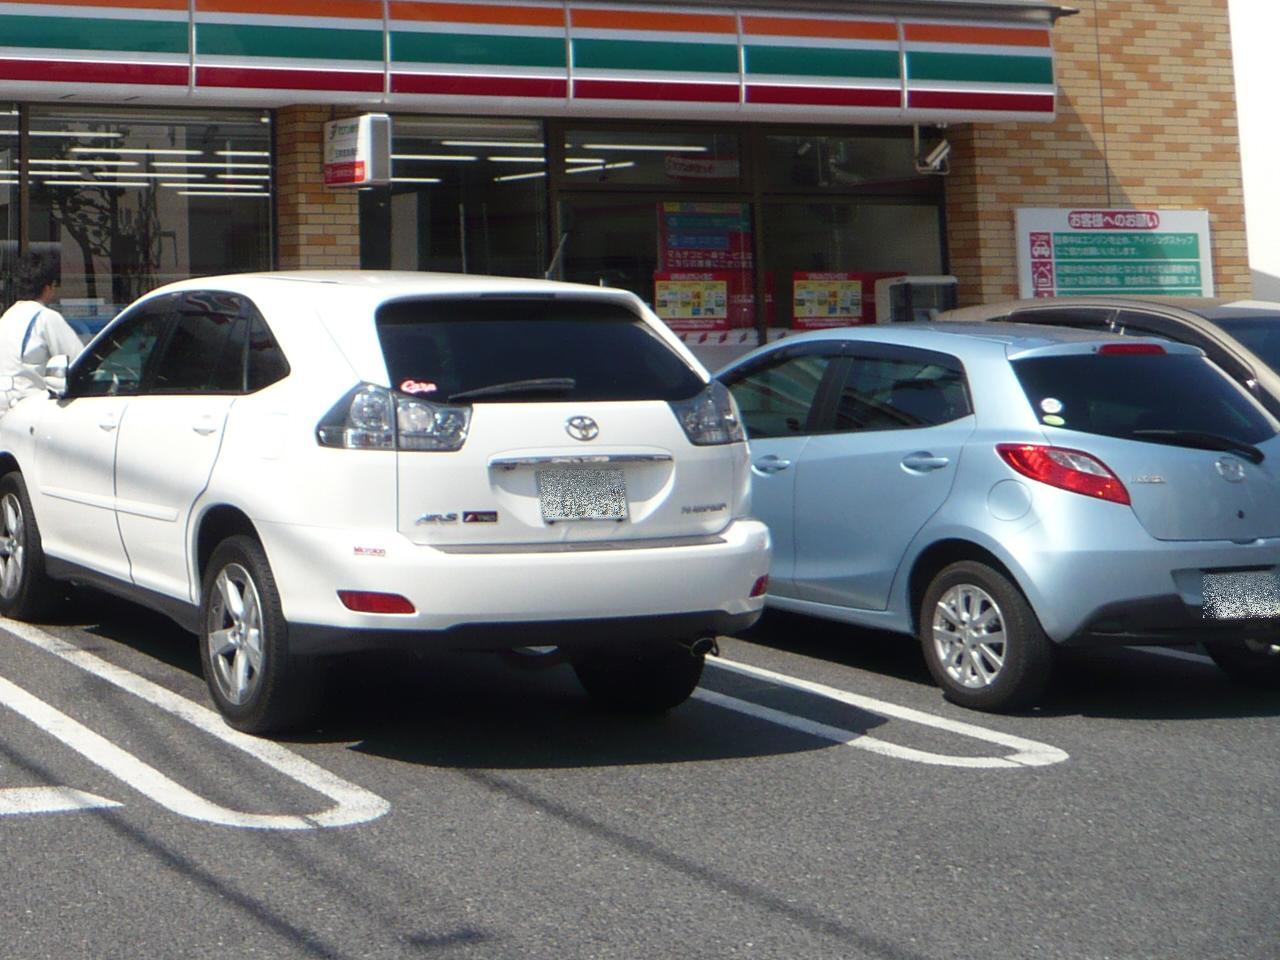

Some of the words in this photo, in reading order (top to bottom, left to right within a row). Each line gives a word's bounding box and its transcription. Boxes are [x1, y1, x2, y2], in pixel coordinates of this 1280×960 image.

[1070, 213, 1158, 228] お客様へのお願い
